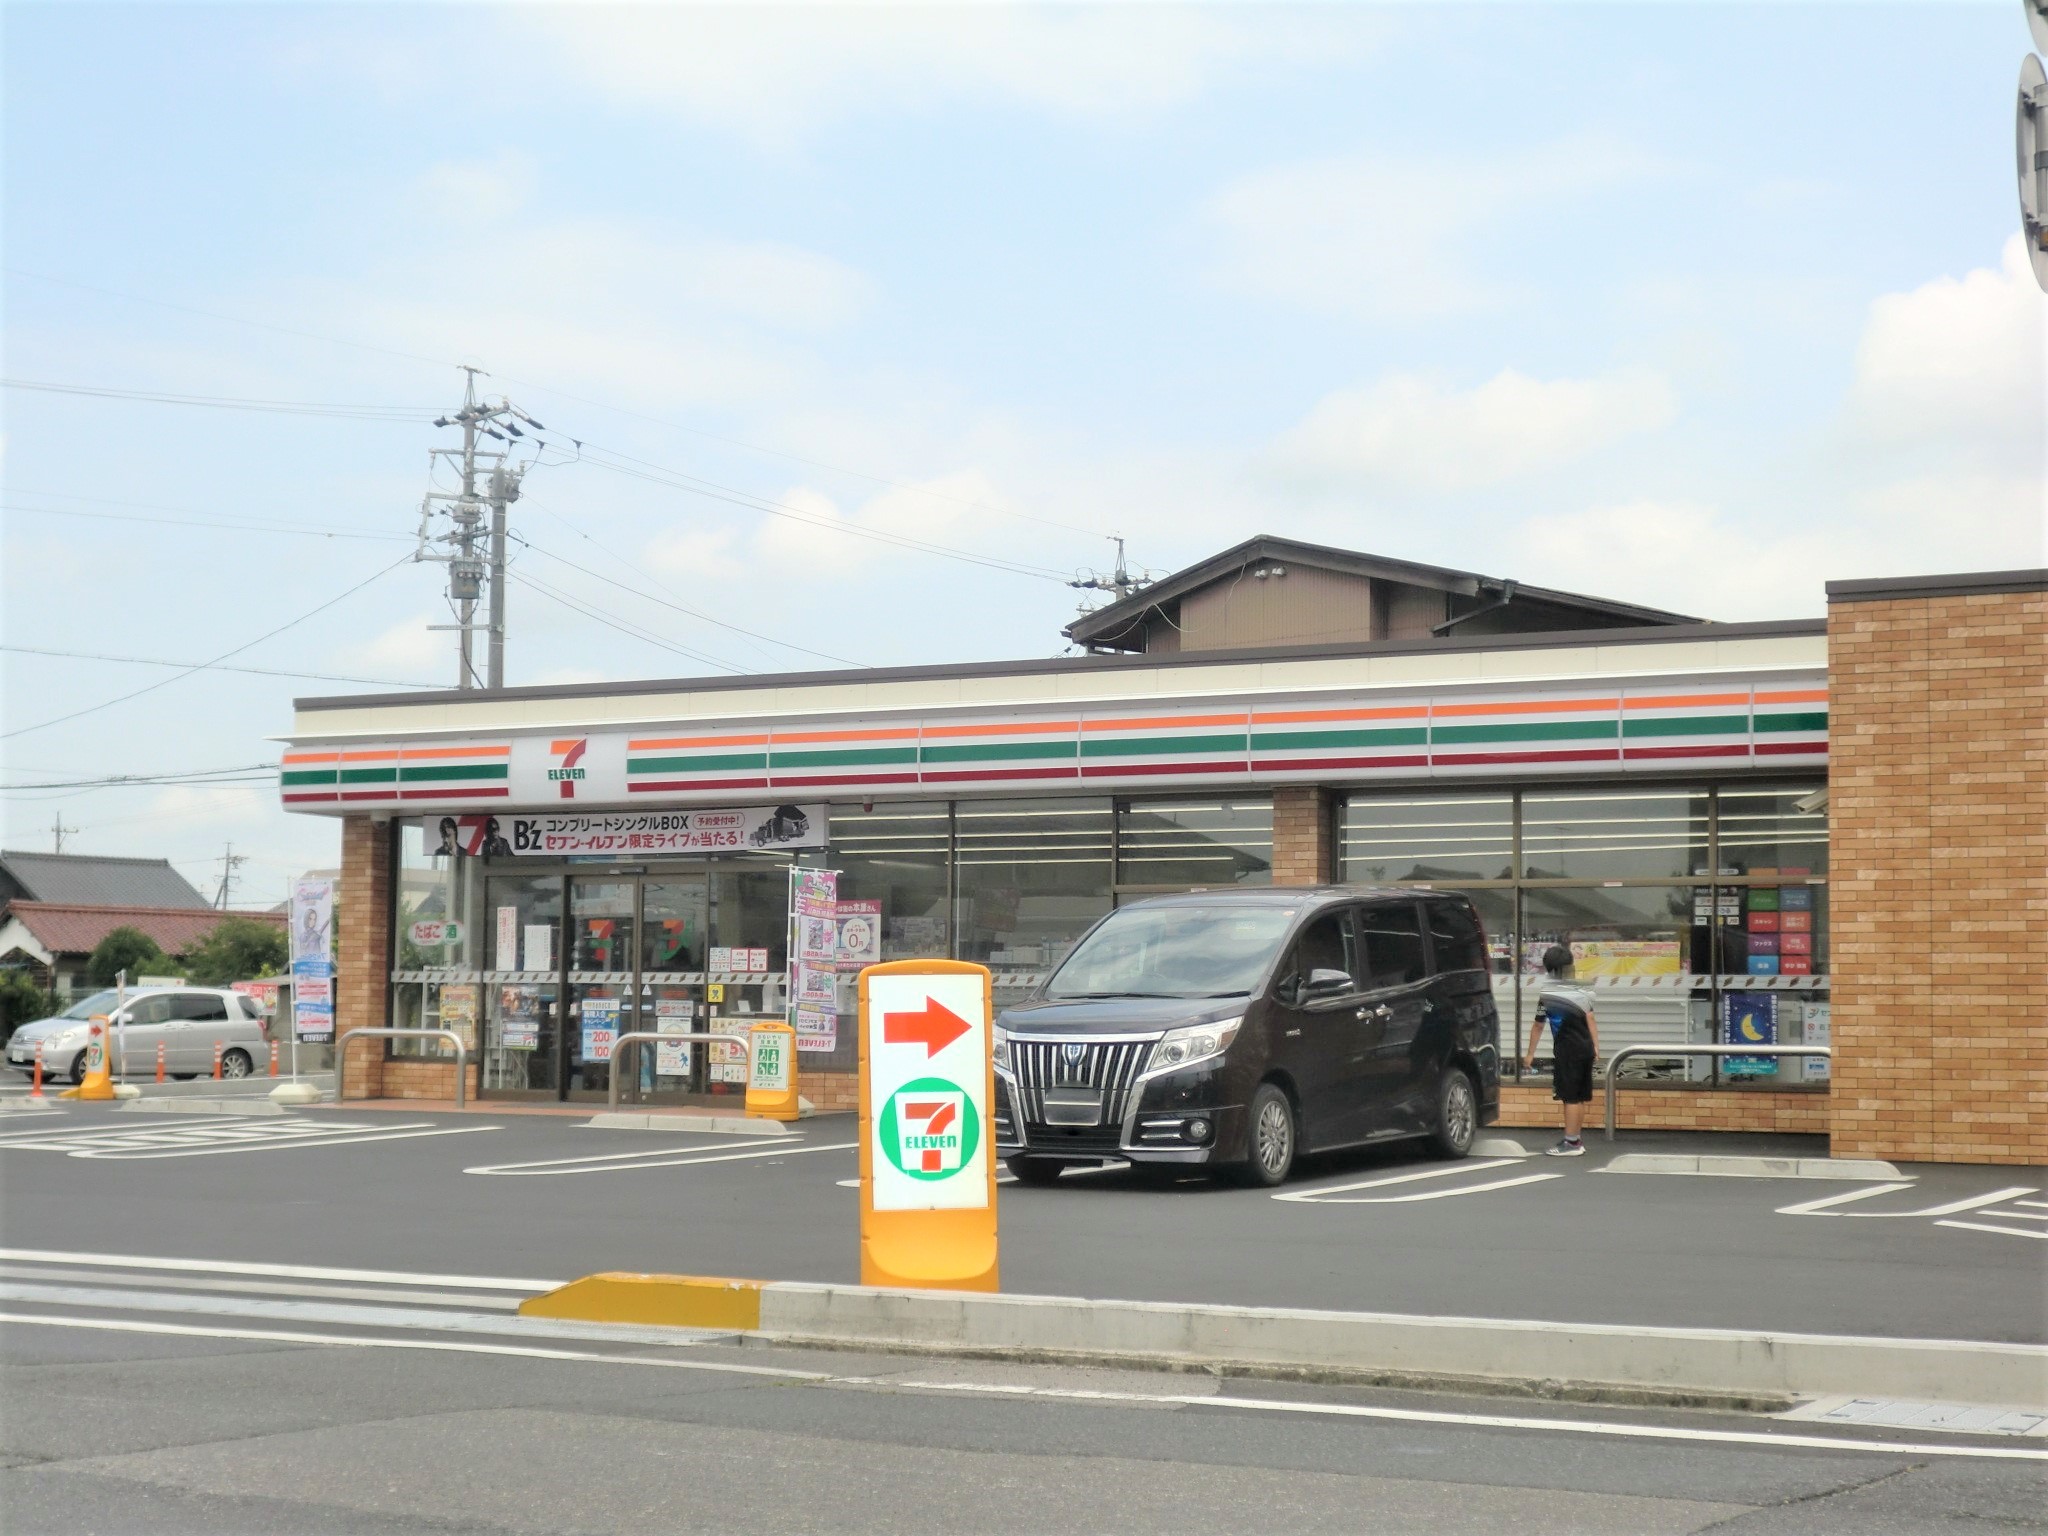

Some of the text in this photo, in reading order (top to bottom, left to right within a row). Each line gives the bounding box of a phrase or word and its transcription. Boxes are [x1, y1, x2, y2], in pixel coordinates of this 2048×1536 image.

[549, 739, 587, 798] 7
[514, 815, 689, 850] B'z コンプリートシングルBOX
[415, 924, 457, 939] たばこ 酒
[592, 1031, 610, 1042] 200
[594, 1046, 609, 1058] 100
[905, 1102, 956, 1172] 7
